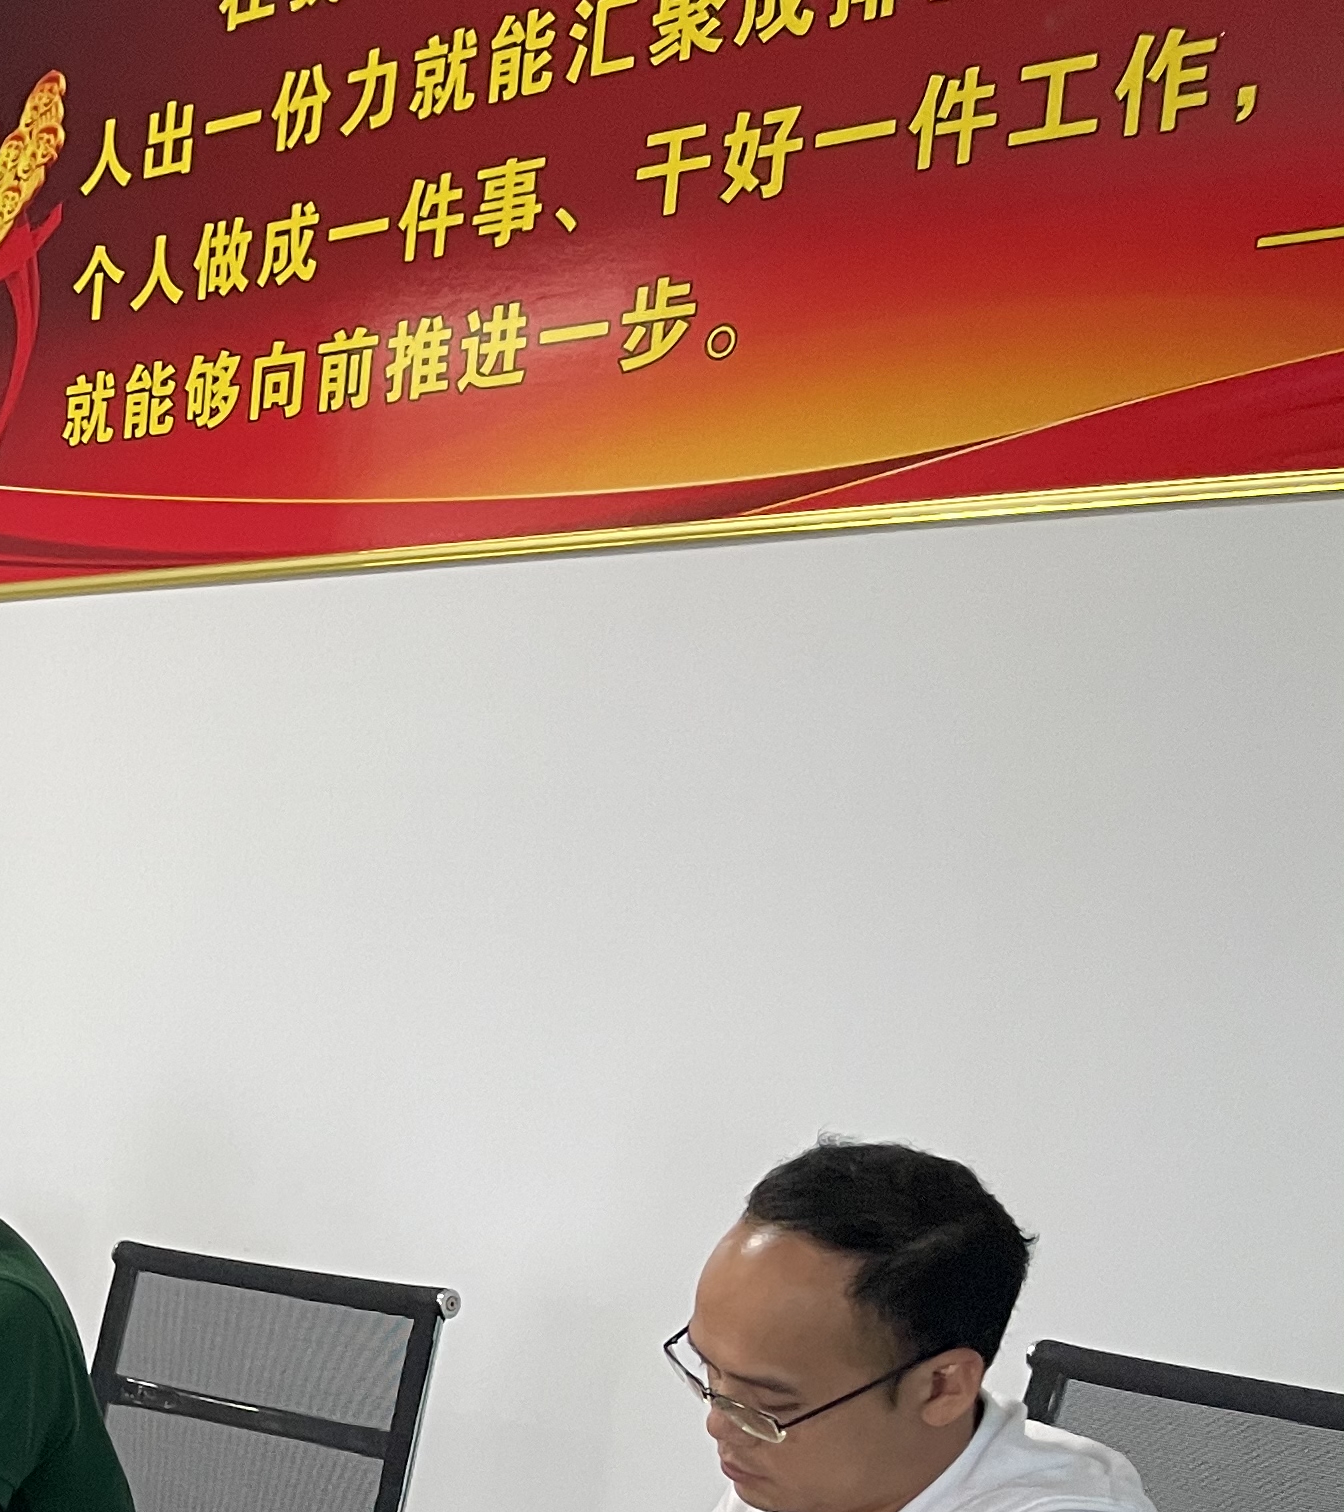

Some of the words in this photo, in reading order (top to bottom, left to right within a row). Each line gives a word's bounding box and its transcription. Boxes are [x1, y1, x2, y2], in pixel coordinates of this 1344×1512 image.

[72, 26, 1260, 322] 个人做成一件事、干好一件工作，
[78, 0, 954, 196] 人出一份力就能汇聚成
[60, 276, 740, 450] 就能够向前推进一步。
